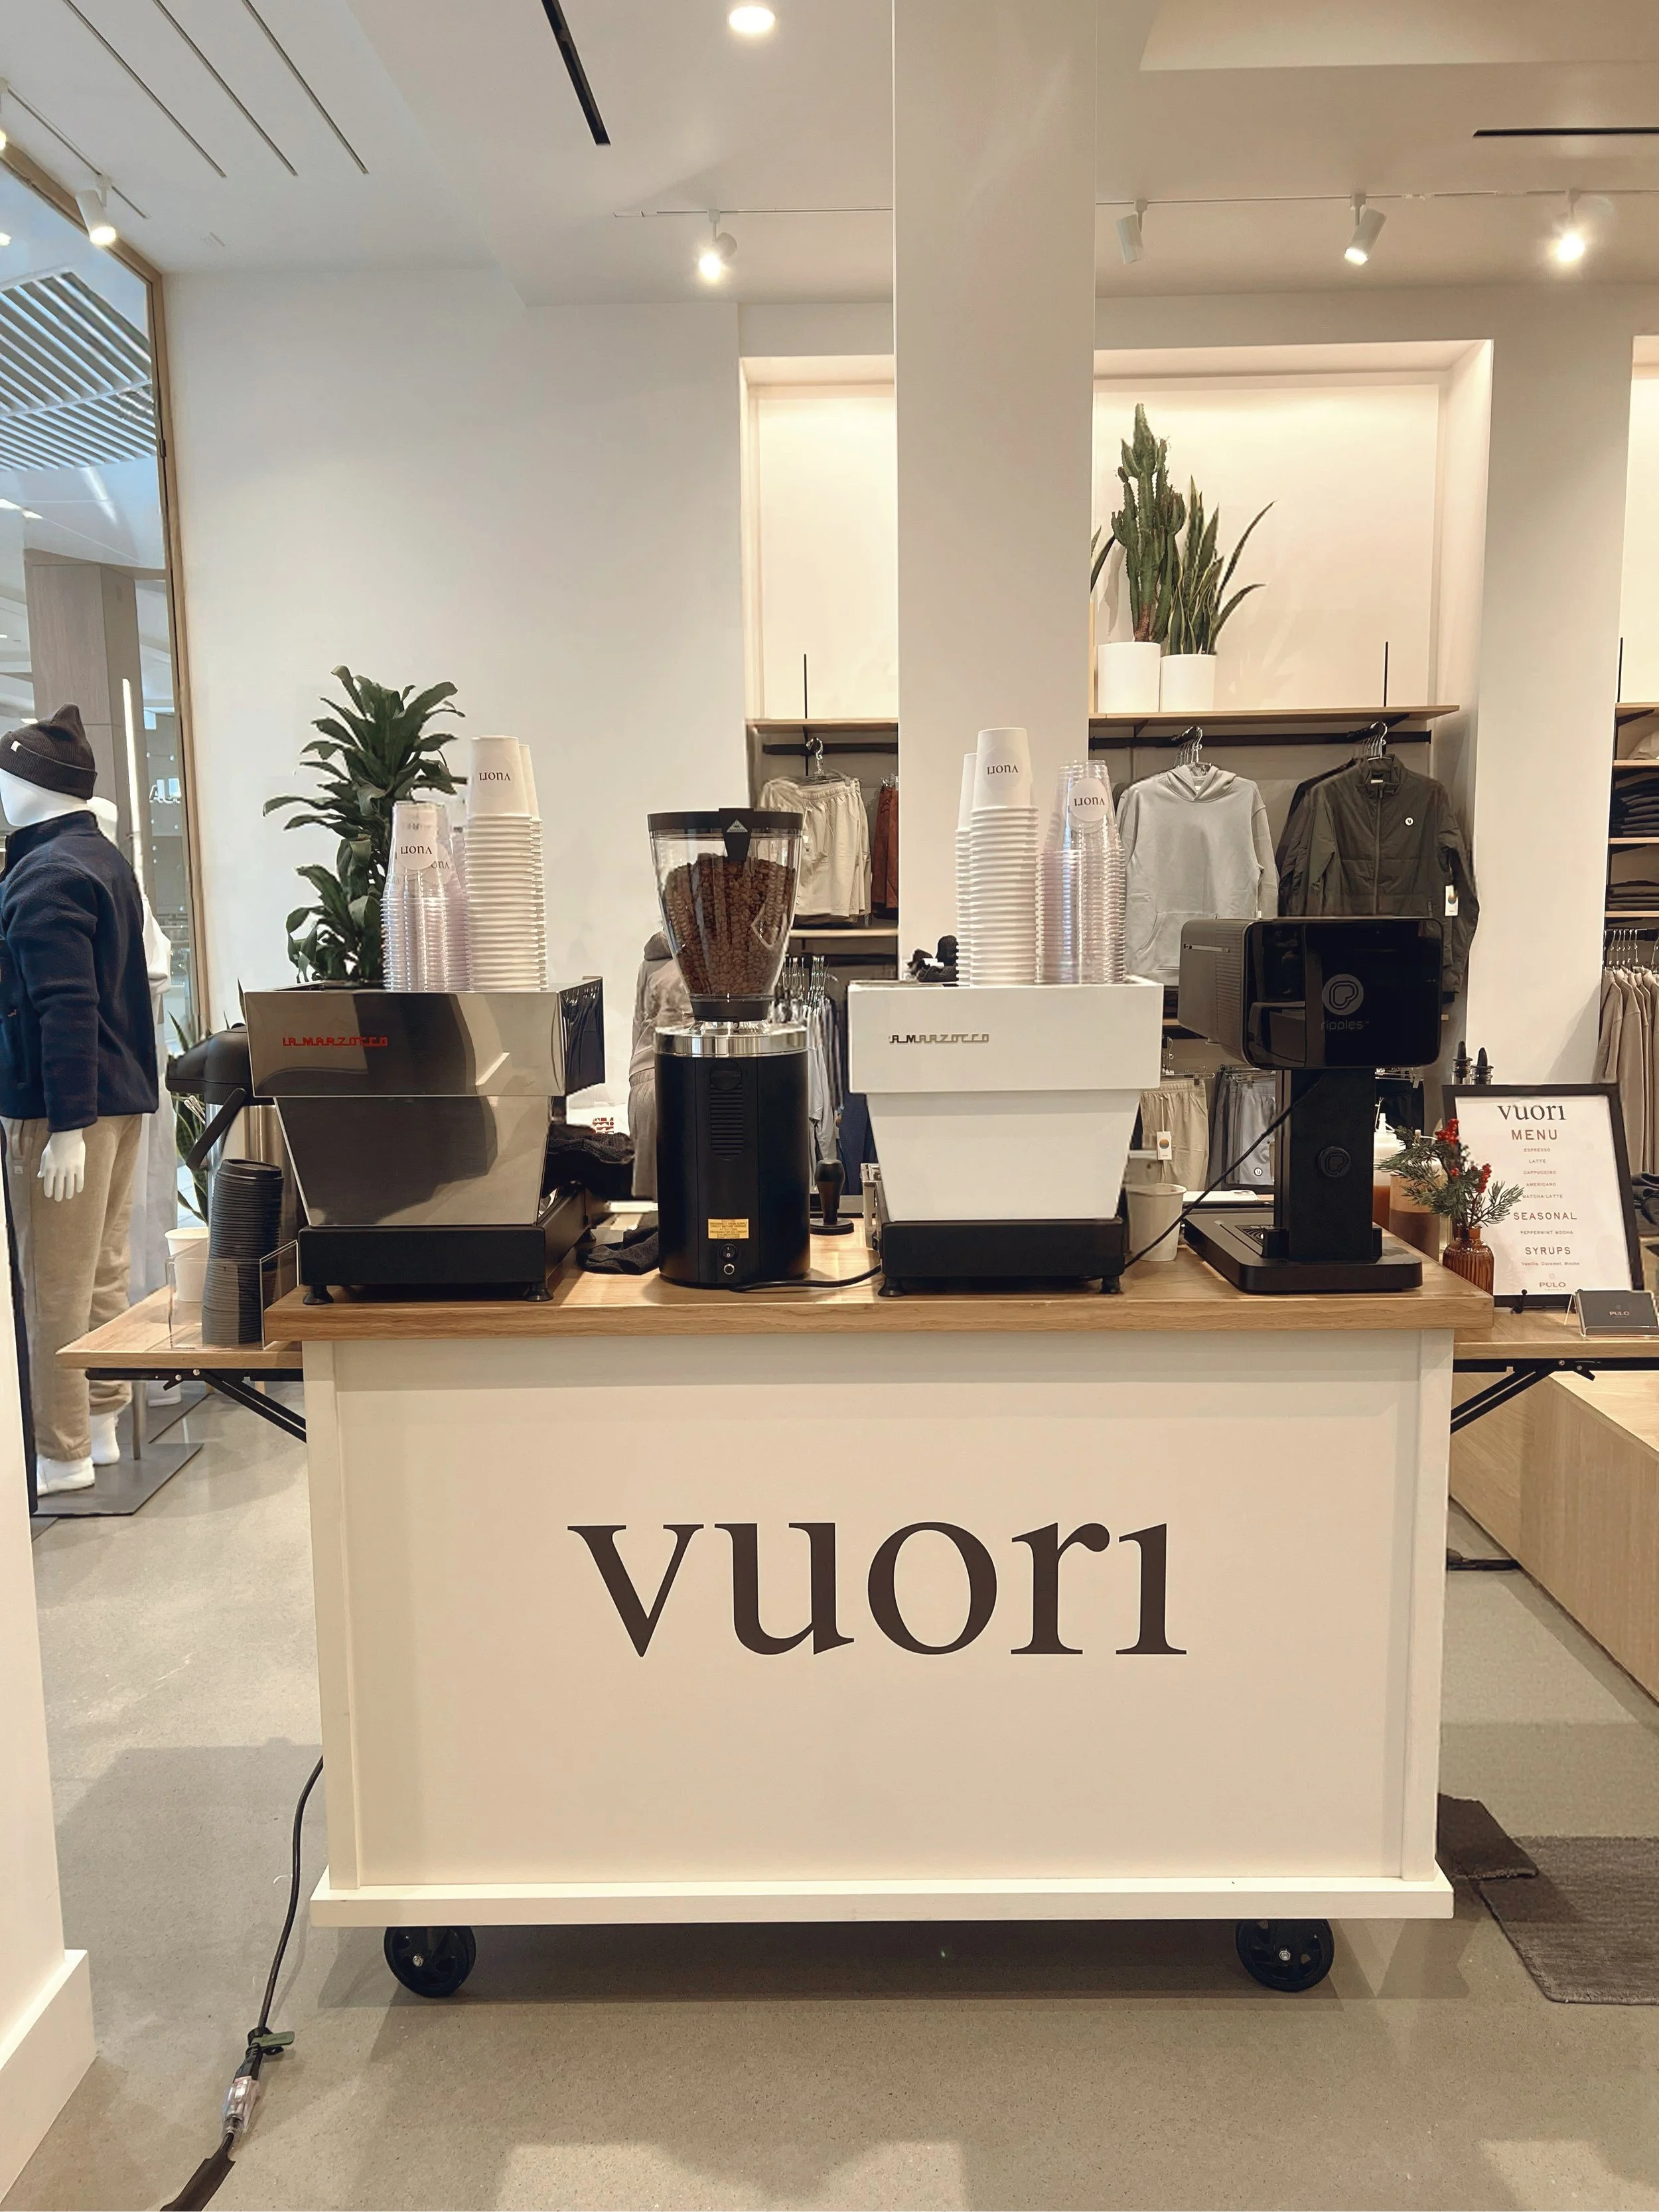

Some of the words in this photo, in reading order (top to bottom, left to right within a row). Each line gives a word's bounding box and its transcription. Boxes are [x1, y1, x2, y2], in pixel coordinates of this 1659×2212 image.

[987, 765, 1019, 774] vuori
[478, 772, 511, 780] vuori
[1074, 796, 1105, 806] vuori
[400, 846, 432, 854] vuori
[1321, 1019, 1364, 1031] ripples
[1497, 1104, 1567, 1120] vuori
[1511, 1130, 1557, 1140] MENU
[1513, 1212, 1577, 1220] SEASONAL
[1525, 1246, 1571, 1255] SYRUPS
[567, 1522, 1187, 1658] vuori
